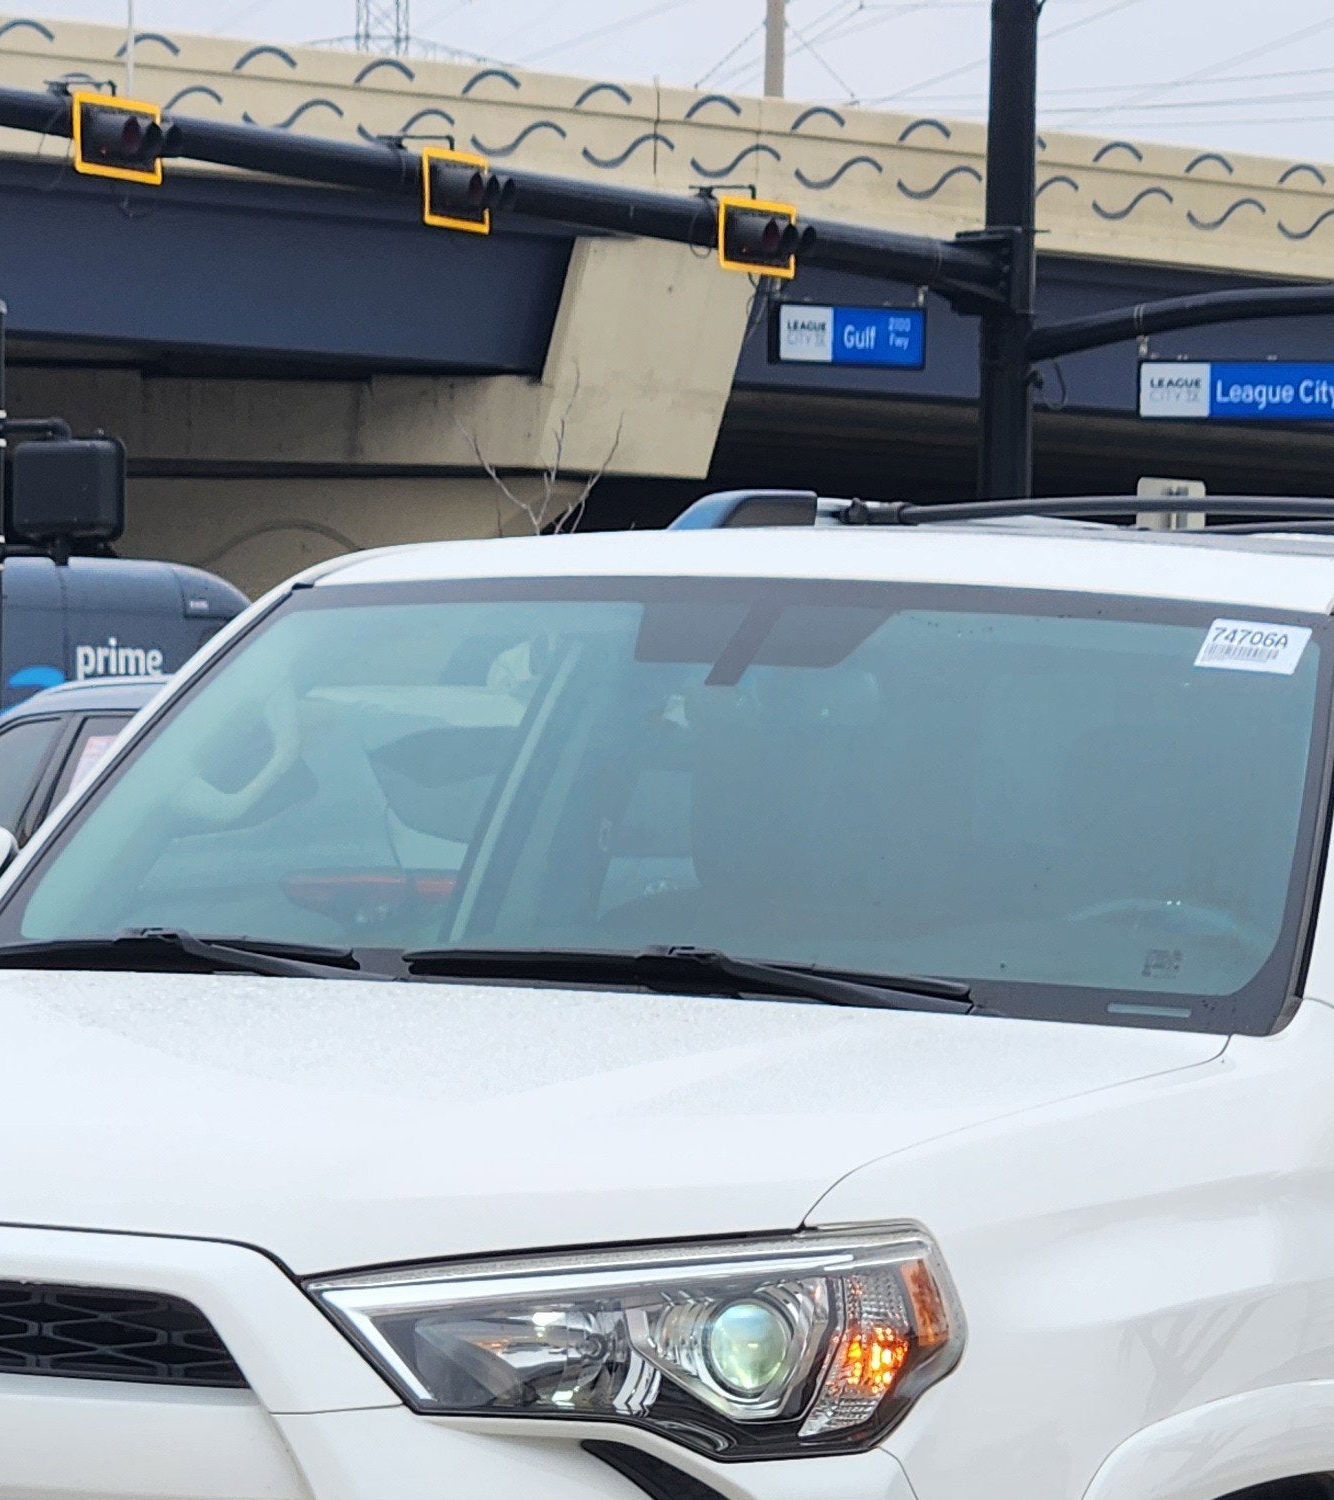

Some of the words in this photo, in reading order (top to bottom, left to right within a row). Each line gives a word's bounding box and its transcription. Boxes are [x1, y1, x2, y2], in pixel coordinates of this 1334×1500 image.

[786, 319, 827, 332] LEAGUE
[843, 324, 876, 350] Gulf
[1149, 376, 1202, 389] LEAGUE
[1217, 379, 1295, 410] League
[1212, 626, 1290, 649] 74706A
[76, 637, 163, 681] prime
